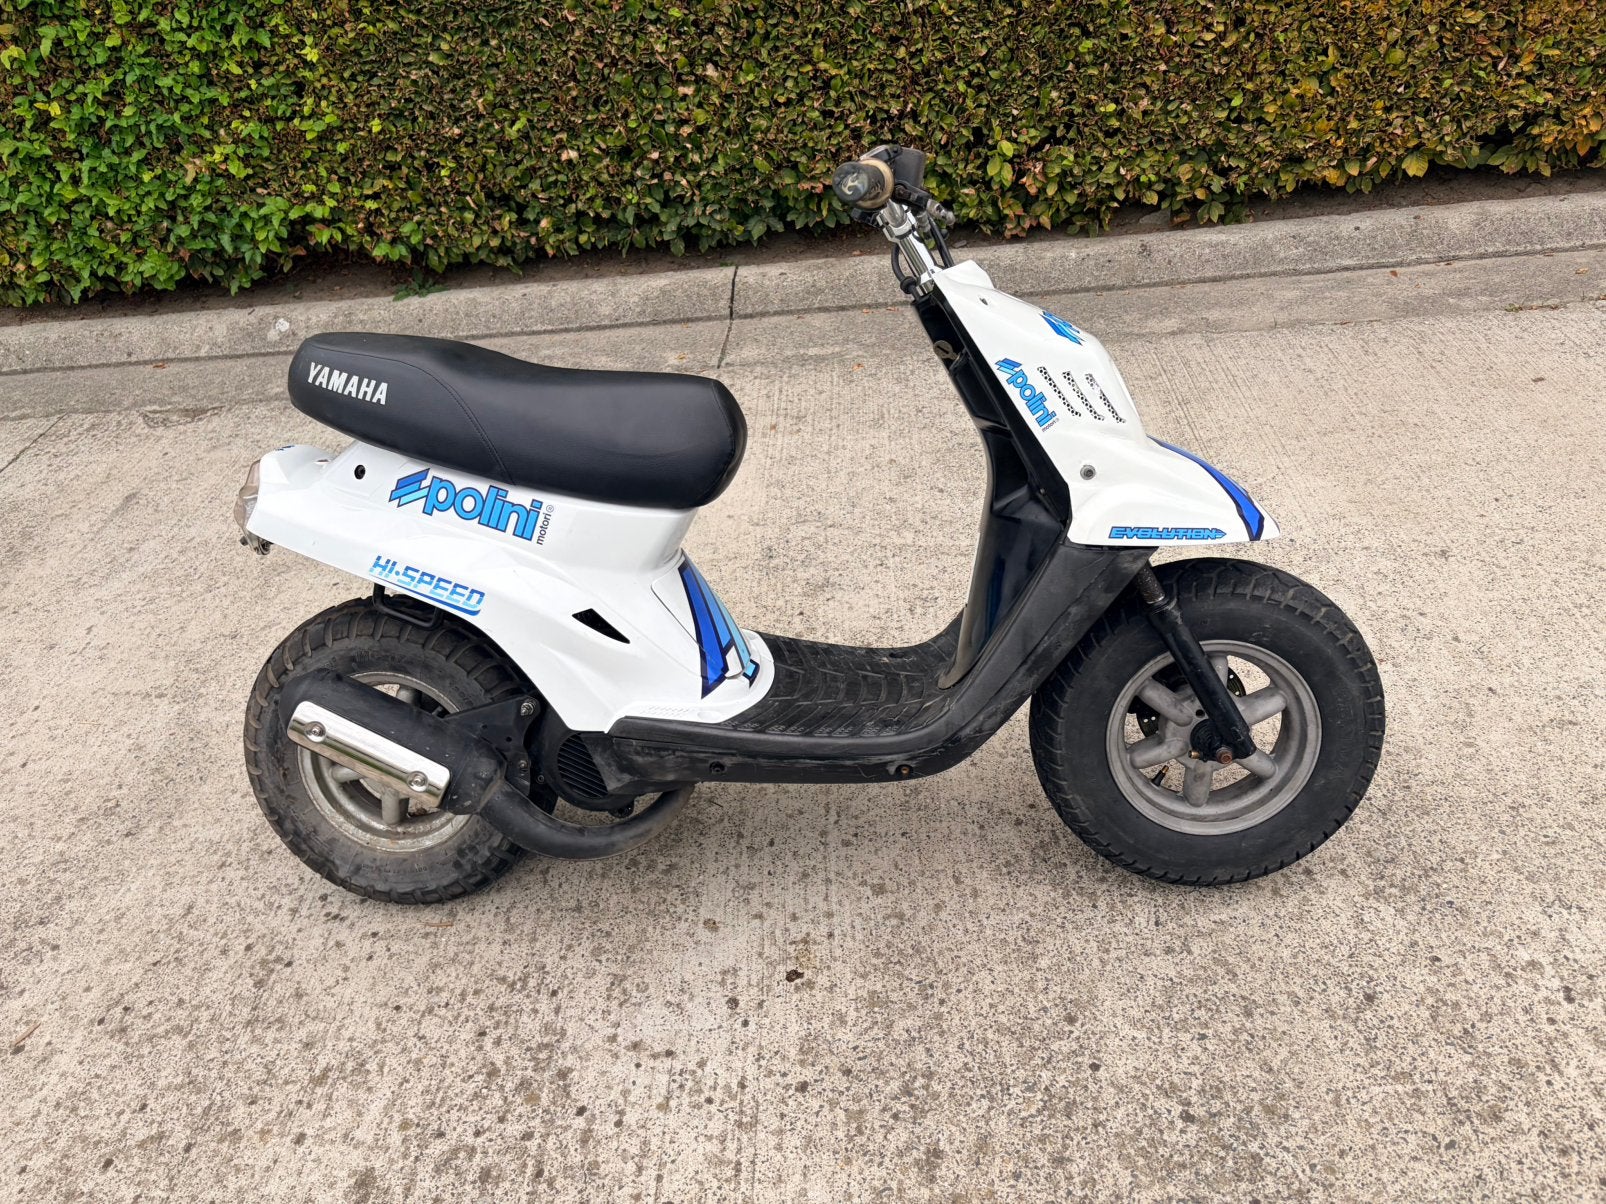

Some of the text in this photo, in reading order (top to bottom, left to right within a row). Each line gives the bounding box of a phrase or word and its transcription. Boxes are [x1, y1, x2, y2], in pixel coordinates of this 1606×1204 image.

[307, 362, 388, 405] YAMAHA
[1006, 369, 1057, 428] polini
[422, 476, 544, 542] polini
[1109, 526, 1219, 540] EVOLUTION
